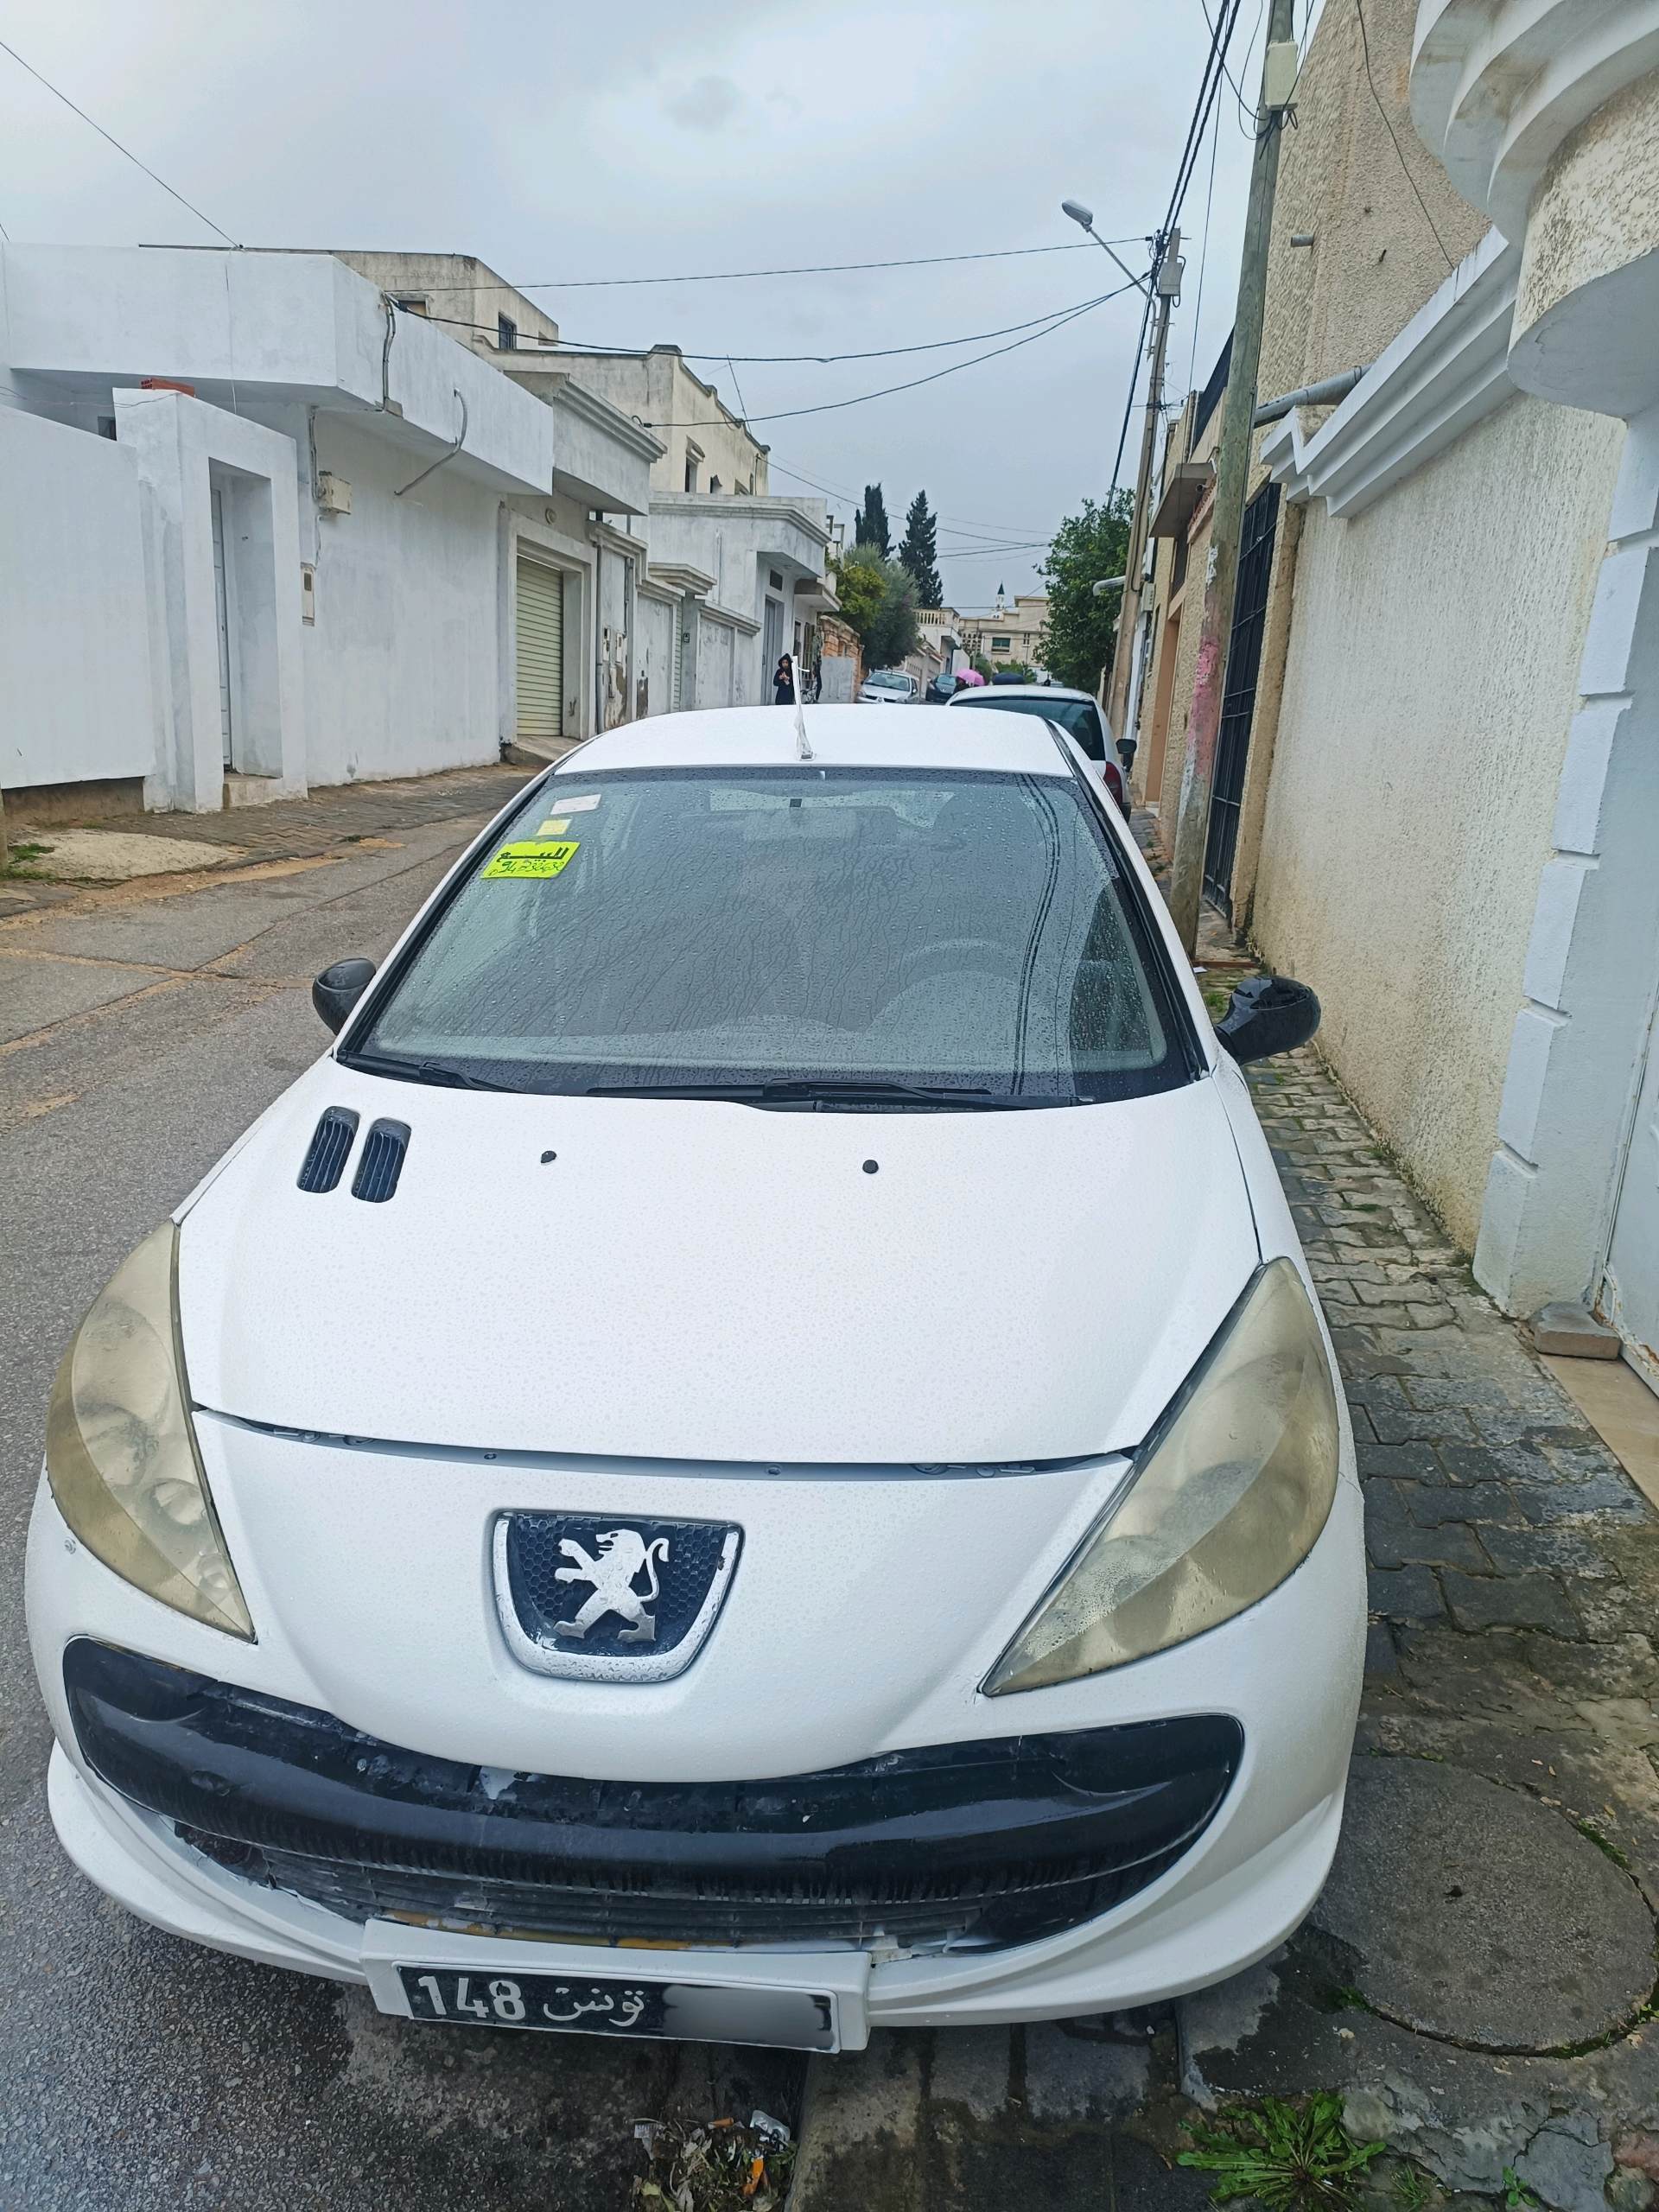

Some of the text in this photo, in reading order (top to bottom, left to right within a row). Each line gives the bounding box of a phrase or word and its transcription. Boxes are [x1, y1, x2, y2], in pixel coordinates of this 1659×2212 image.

[496, 847, 569, 863] للبيع
[418, 1975, 526, 2021] 148
[543, 1986, 645, 2027] تونس
